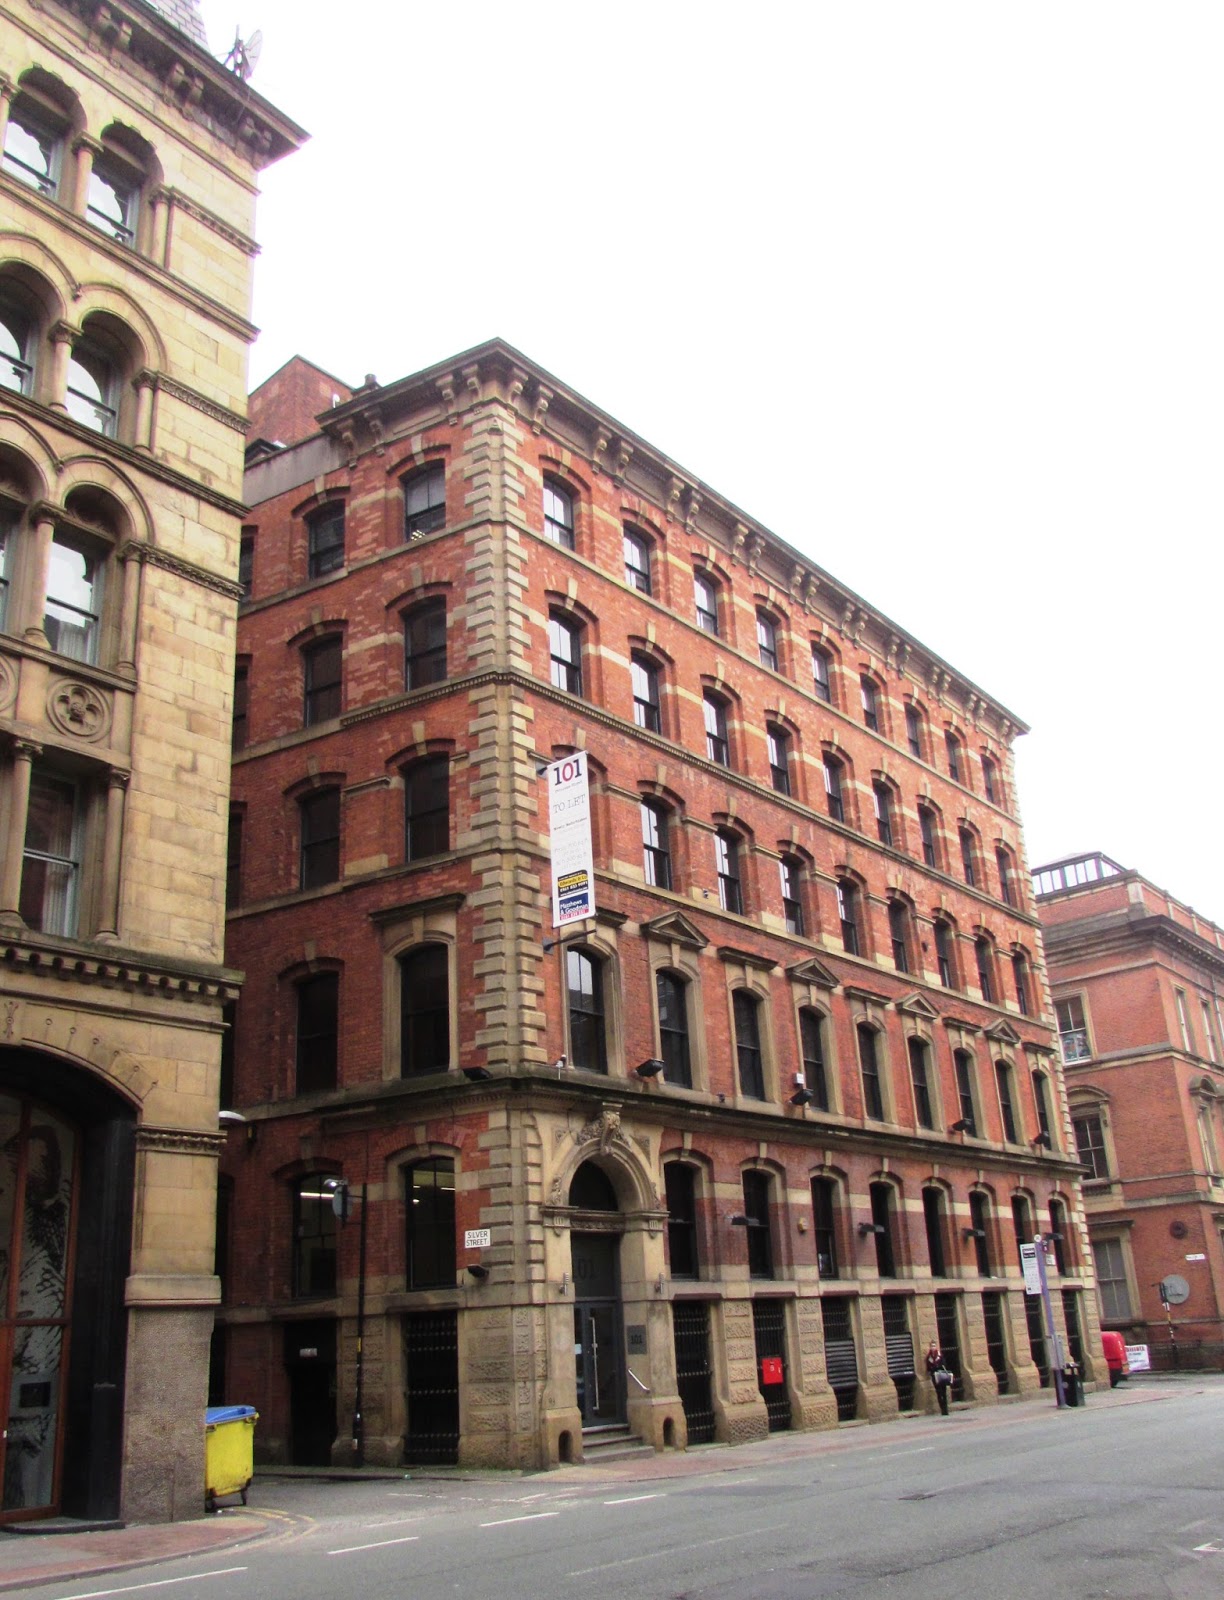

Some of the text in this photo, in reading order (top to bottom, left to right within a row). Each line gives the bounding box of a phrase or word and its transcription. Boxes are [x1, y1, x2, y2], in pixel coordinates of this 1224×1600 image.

[553, 759, 582, 786] 101
[553, 794, 586, 814] TO LET
[467, 1230, 488, 1239] SILVER
[466, 1238, 488, 1247] STREET
